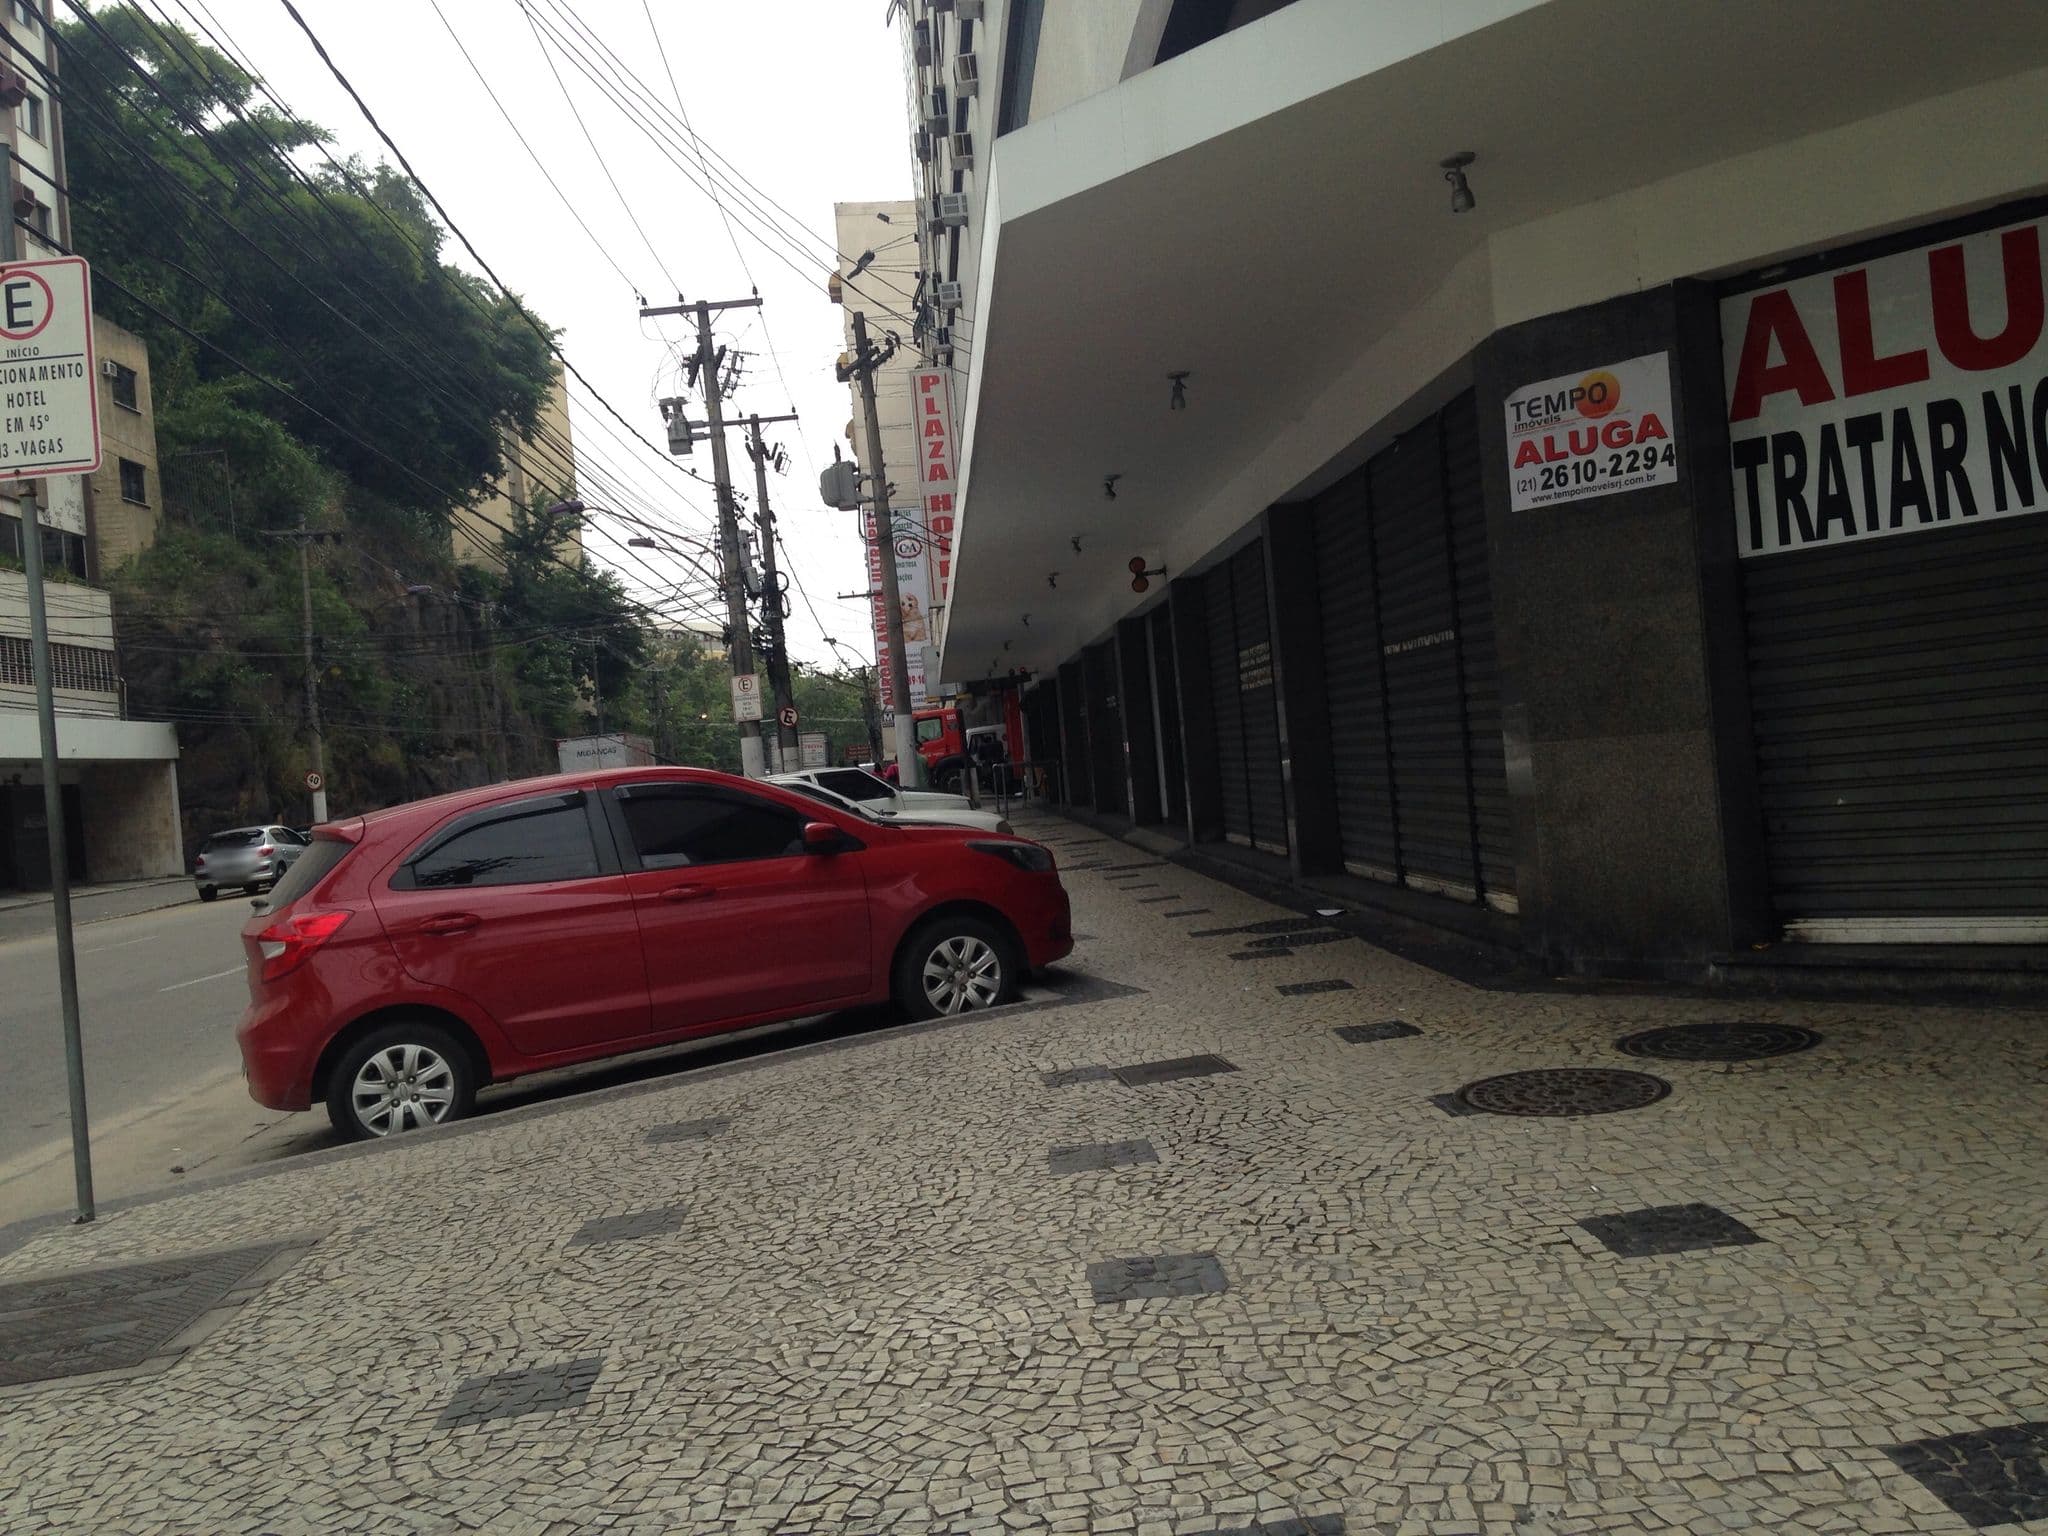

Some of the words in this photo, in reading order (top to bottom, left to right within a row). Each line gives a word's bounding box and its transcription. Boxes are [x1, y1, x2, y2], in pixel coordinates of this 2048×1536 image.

[4, 281, 34, 329] E
[1729, 225, 2045, 423] ALU
[6, 346, 40, 359] INÍCIO
[7, 390, 46, 409] HOTEL
[1510, 382, 1608, 423] TEMPO
[6, 417, 24, 434] EM
[920, 375, 949, 482] PLAZA
[1514, 414, 1561, 432] imóveis
[1514, 413, 1668, 469] ALUGA
[1517, 477, 1537, 495] (21)
[1540, 443, 1675, 491] 2610-2294
[1732, 398, 1979, 551] TRATAR
[309, 775, 320, 785] 40
